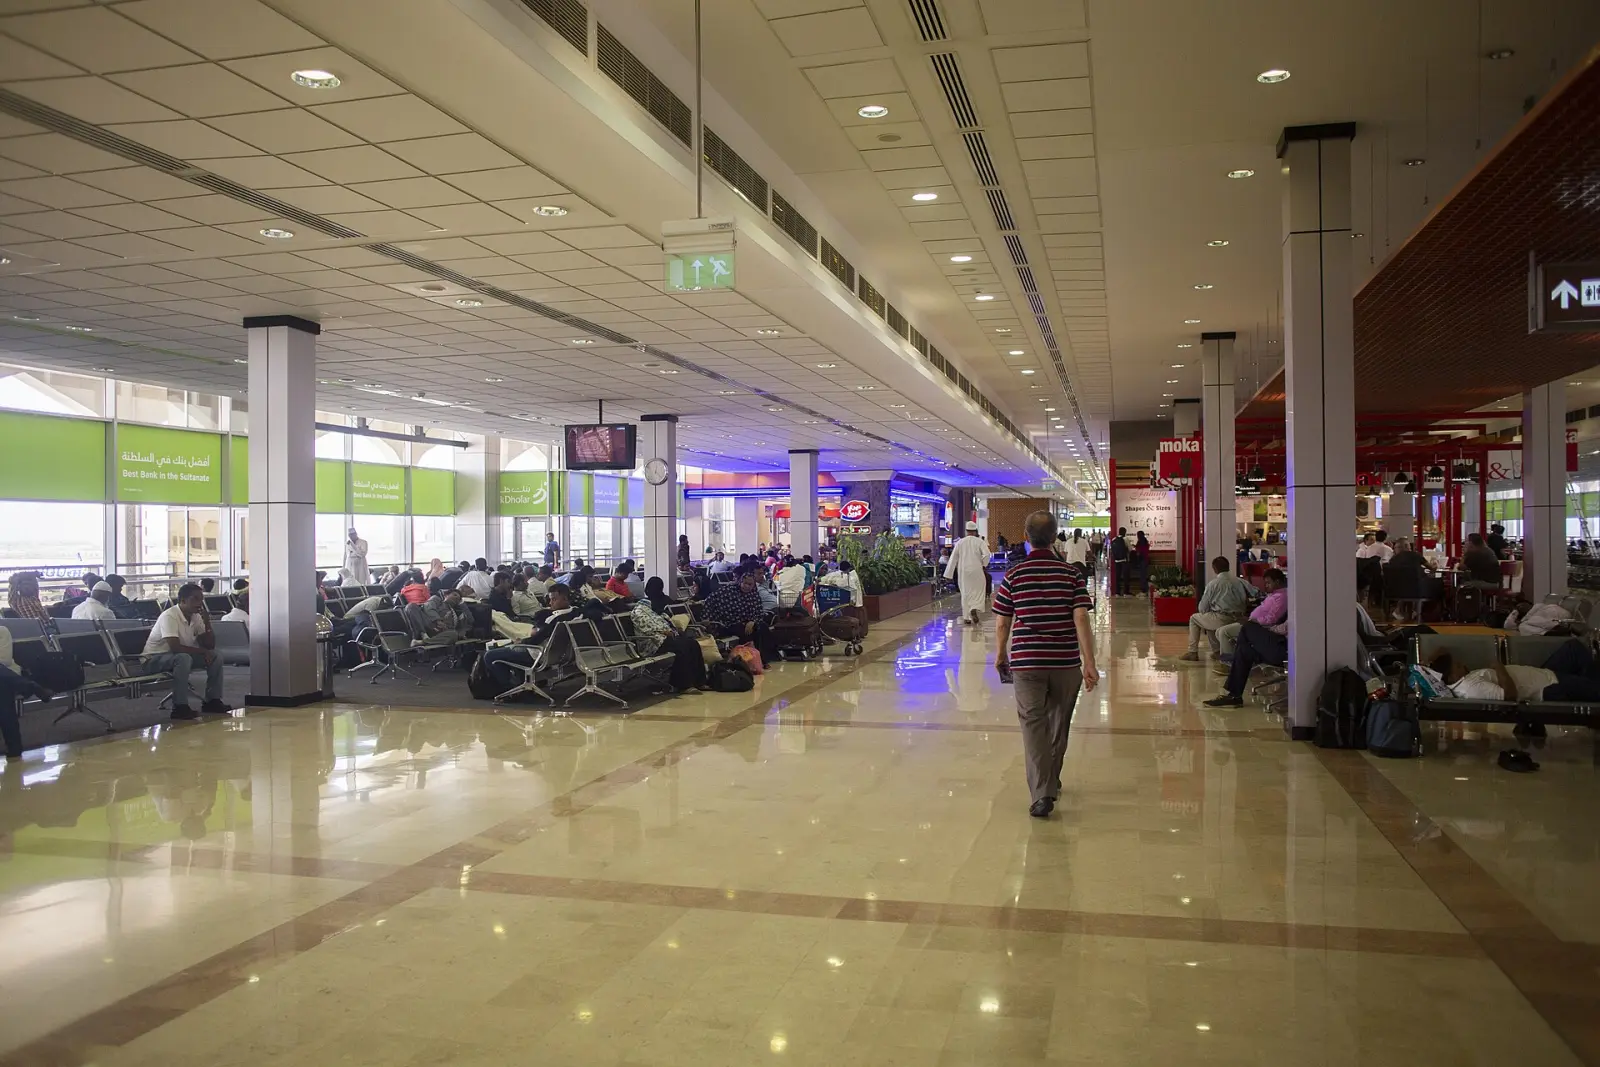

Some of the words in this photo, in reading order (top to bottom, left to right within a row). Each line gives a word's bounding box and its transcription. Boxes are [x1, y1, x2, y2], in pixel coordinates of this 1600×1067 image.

[1160, 438, 1200, 452] moka
[121, 451, 155, 463] السلطنة
[156, 455, 171, 468] في
[172, 455, 187, 468] بنك
[188, 454, 210, 468] أفضل
[122, 469, 139, 478] Best
[140, 470, 158, 479] Bank
[159, 471, 166, 480] in
[167, 472, 178, 480] the
[179, 472, 210, 482] Sultanate
[1146, 502, 1154, 511] &
